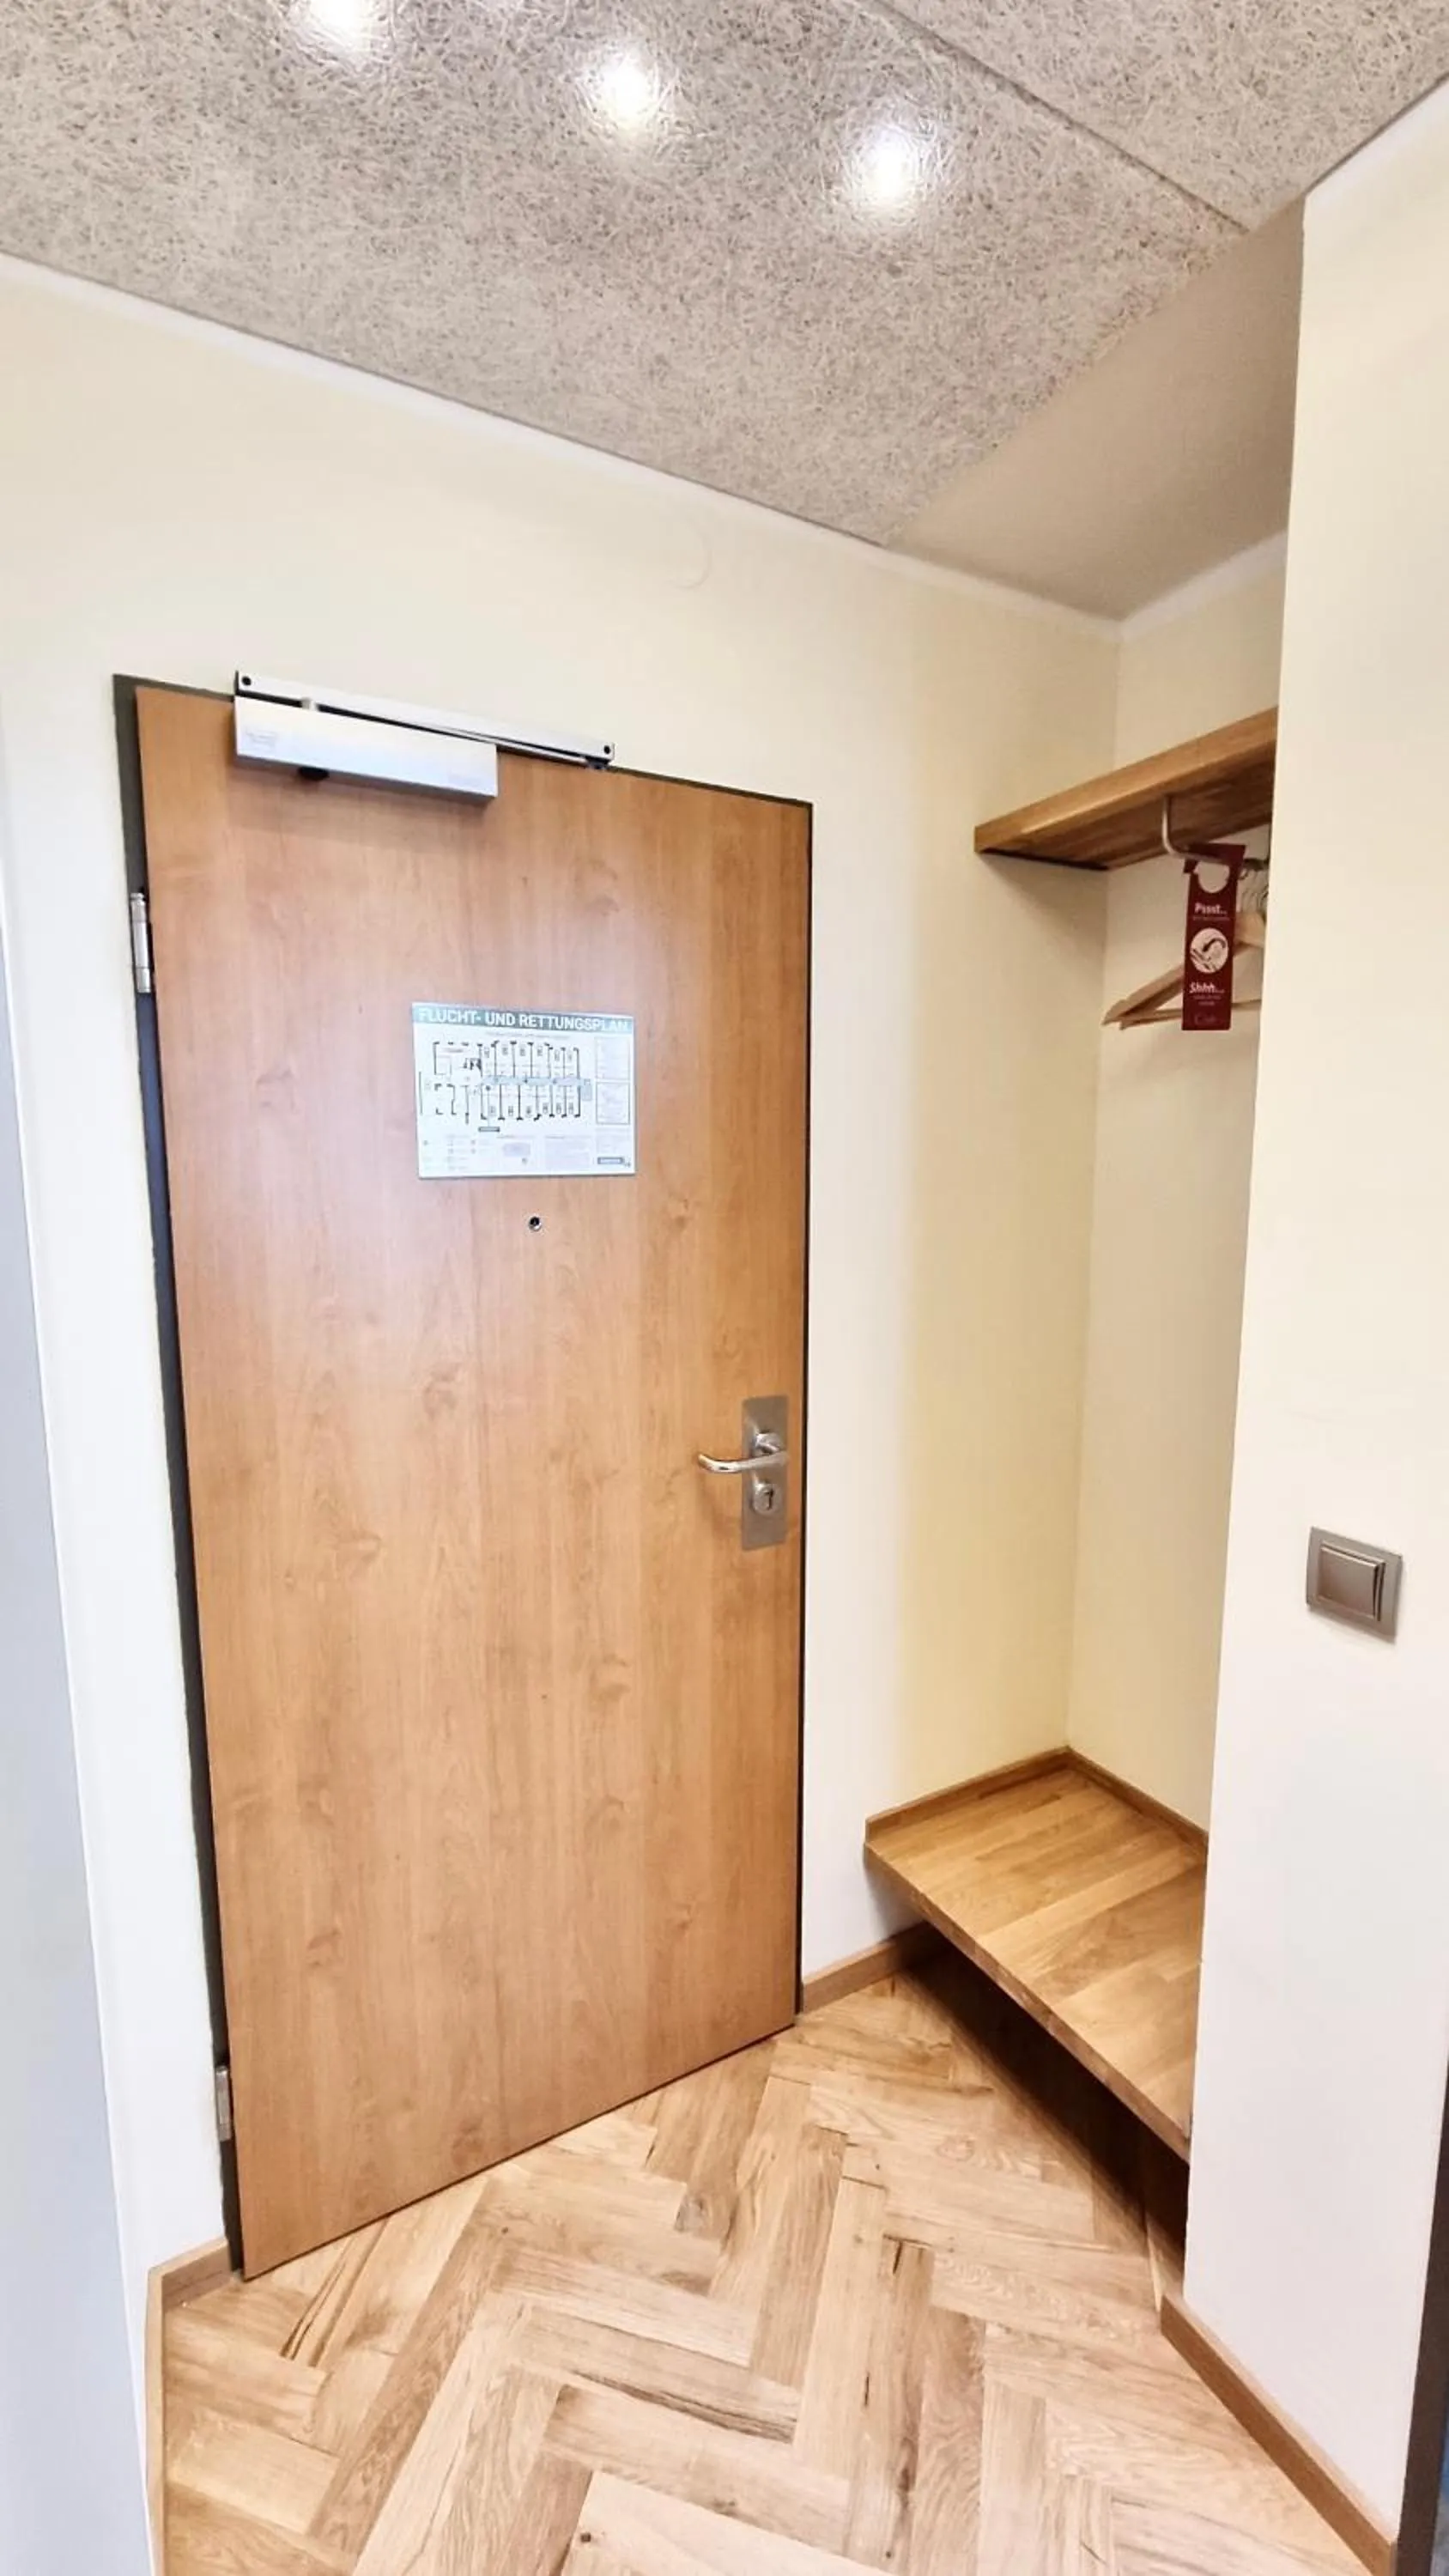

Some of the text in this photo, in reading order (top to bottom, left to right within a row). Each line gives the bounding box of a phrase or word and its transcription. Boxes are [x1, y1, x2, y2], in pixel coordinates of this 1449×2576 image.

[419, 1008, 628, 1031] FLUCHT- UND RETTUNGSPLAN
